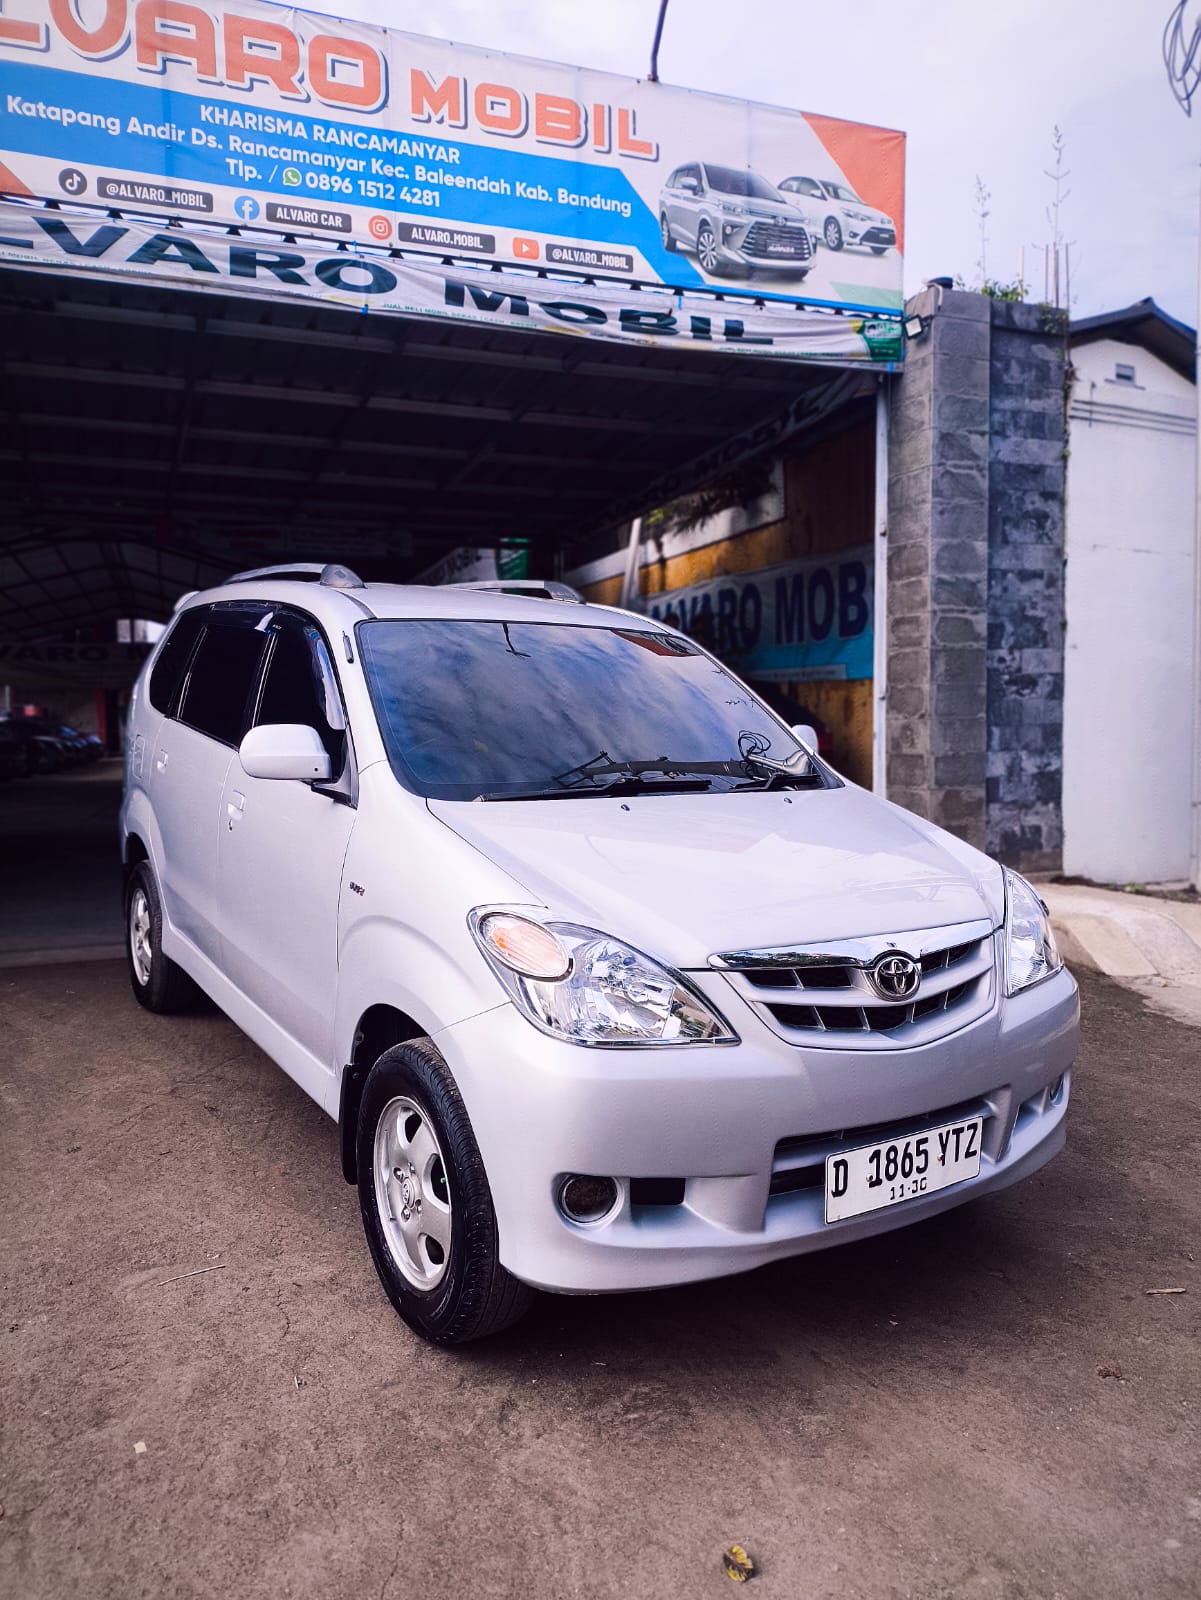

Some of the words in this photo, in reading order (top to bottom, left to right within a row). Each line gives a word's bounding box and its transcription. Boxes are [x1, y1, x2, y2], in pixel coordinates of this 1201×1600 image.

[200, 104, 308, 139] KHARISMA
[313, 124, 460, 164] RANCAMANYAR
[410, 68, 657, 159] MOBIL
[7, 95, 120, 136] Katapang
[126, 116, 185, 142] Andir
[191, 128, 223, 149] Ds.
[229, 135, 366, 172] Rancamanyar
[371, 158, 409, 179] Kec.
[415, 165, 511, 195] Baleendah
[515, 181, 553, 202] Kab.
[557, 188, 632, 218] Bandung
[225, 158, 262, 181] Tlp.
[305, 172, 353, 194] 0896
[358, 179, 395, 200] 1512
[400, 186, 440, 208] 4281
[106, 183, 207, 208] @ALVARO_MOBIL
[276, 207, 319, 224] ALVARO
[321, 213, 343, 228] CAR
[411, 227, 483, 248] ALVARO.MOBIL
[552, 248, 629, 269] @ALVARO_MOBIL
[444, 277, 773, 345] MOBIL
[831, 1158, 848, 1198] D
[868, 1137, 929, 1188] 1865
[938, 1122, 978, 1167] YTZ
